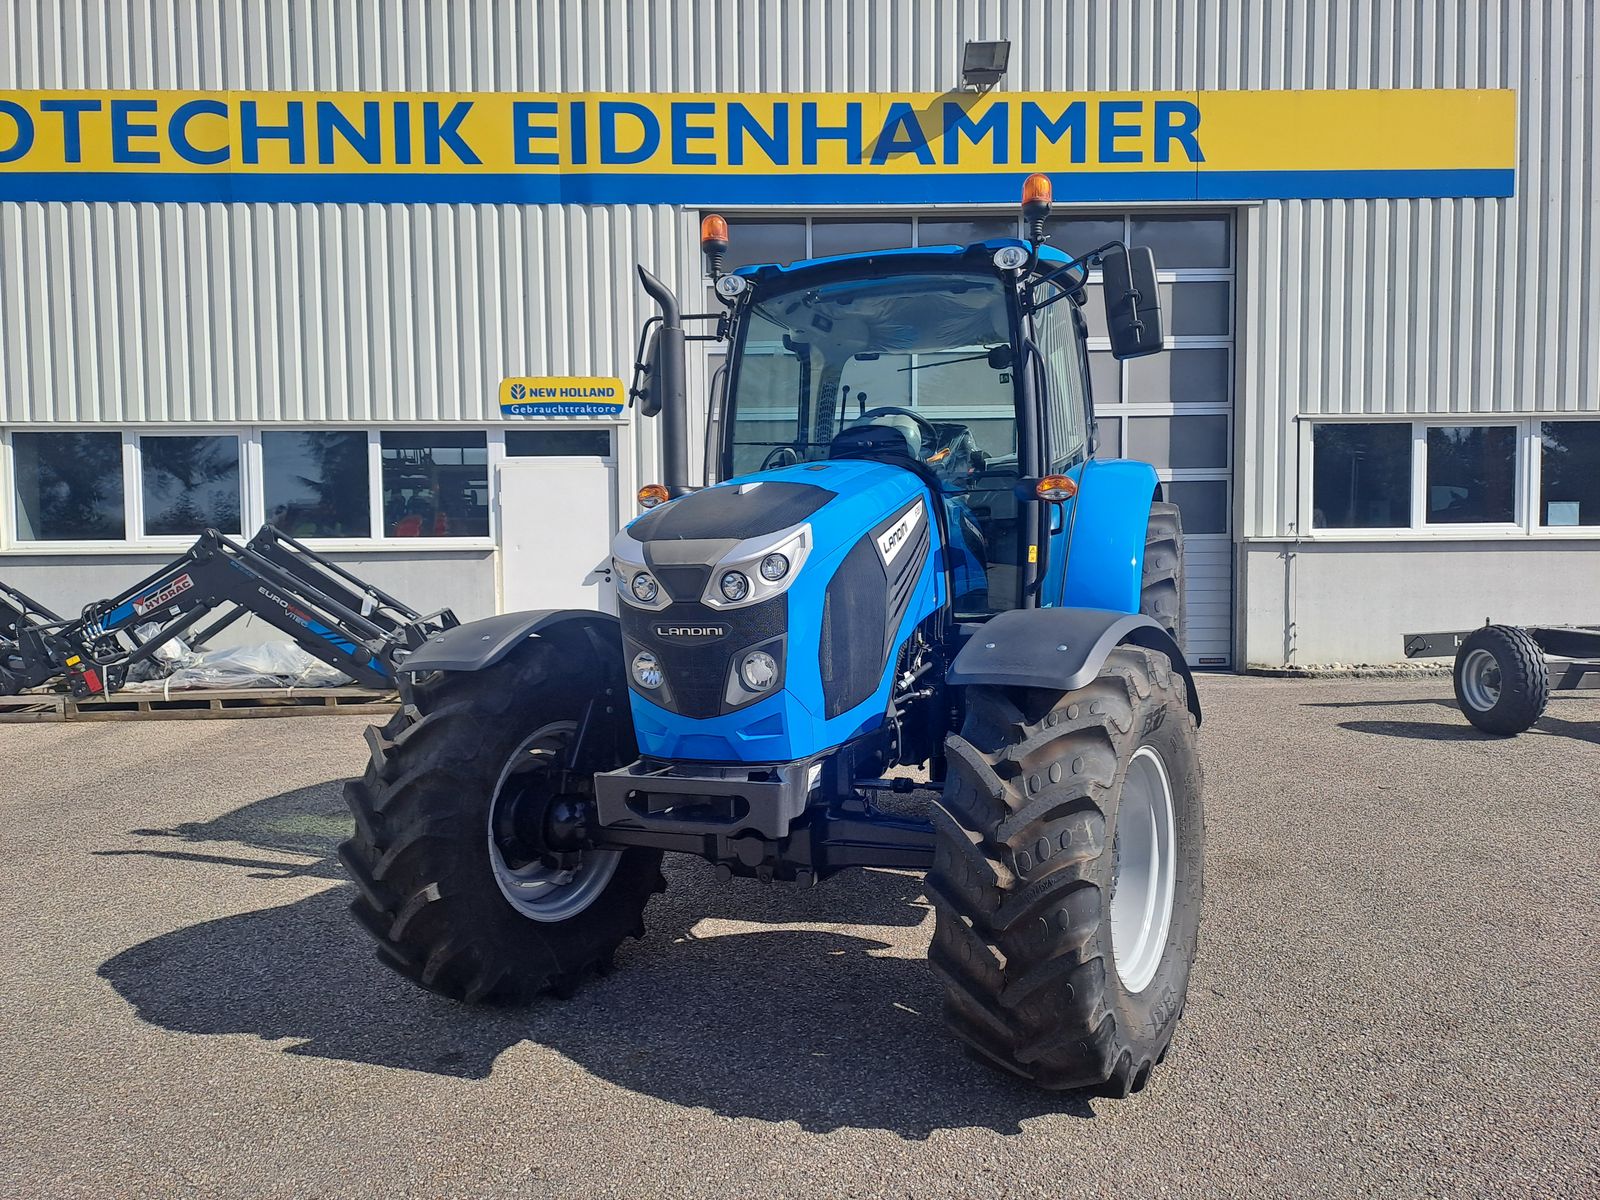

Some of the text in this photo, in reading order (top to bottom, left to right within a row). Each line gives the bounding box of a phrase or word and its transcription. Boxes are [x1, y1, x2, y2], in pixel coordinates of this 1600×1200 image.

[512, 100, 1206, 166] EIDENHAMMER
[529, 387, 615, 398] NEW HOLLAND
[510, 404, 616, 415] Gebrauchttraktore
[144, 580, 191, 610] HYDRAC
[657, 627, 723, 636] LANDINI
